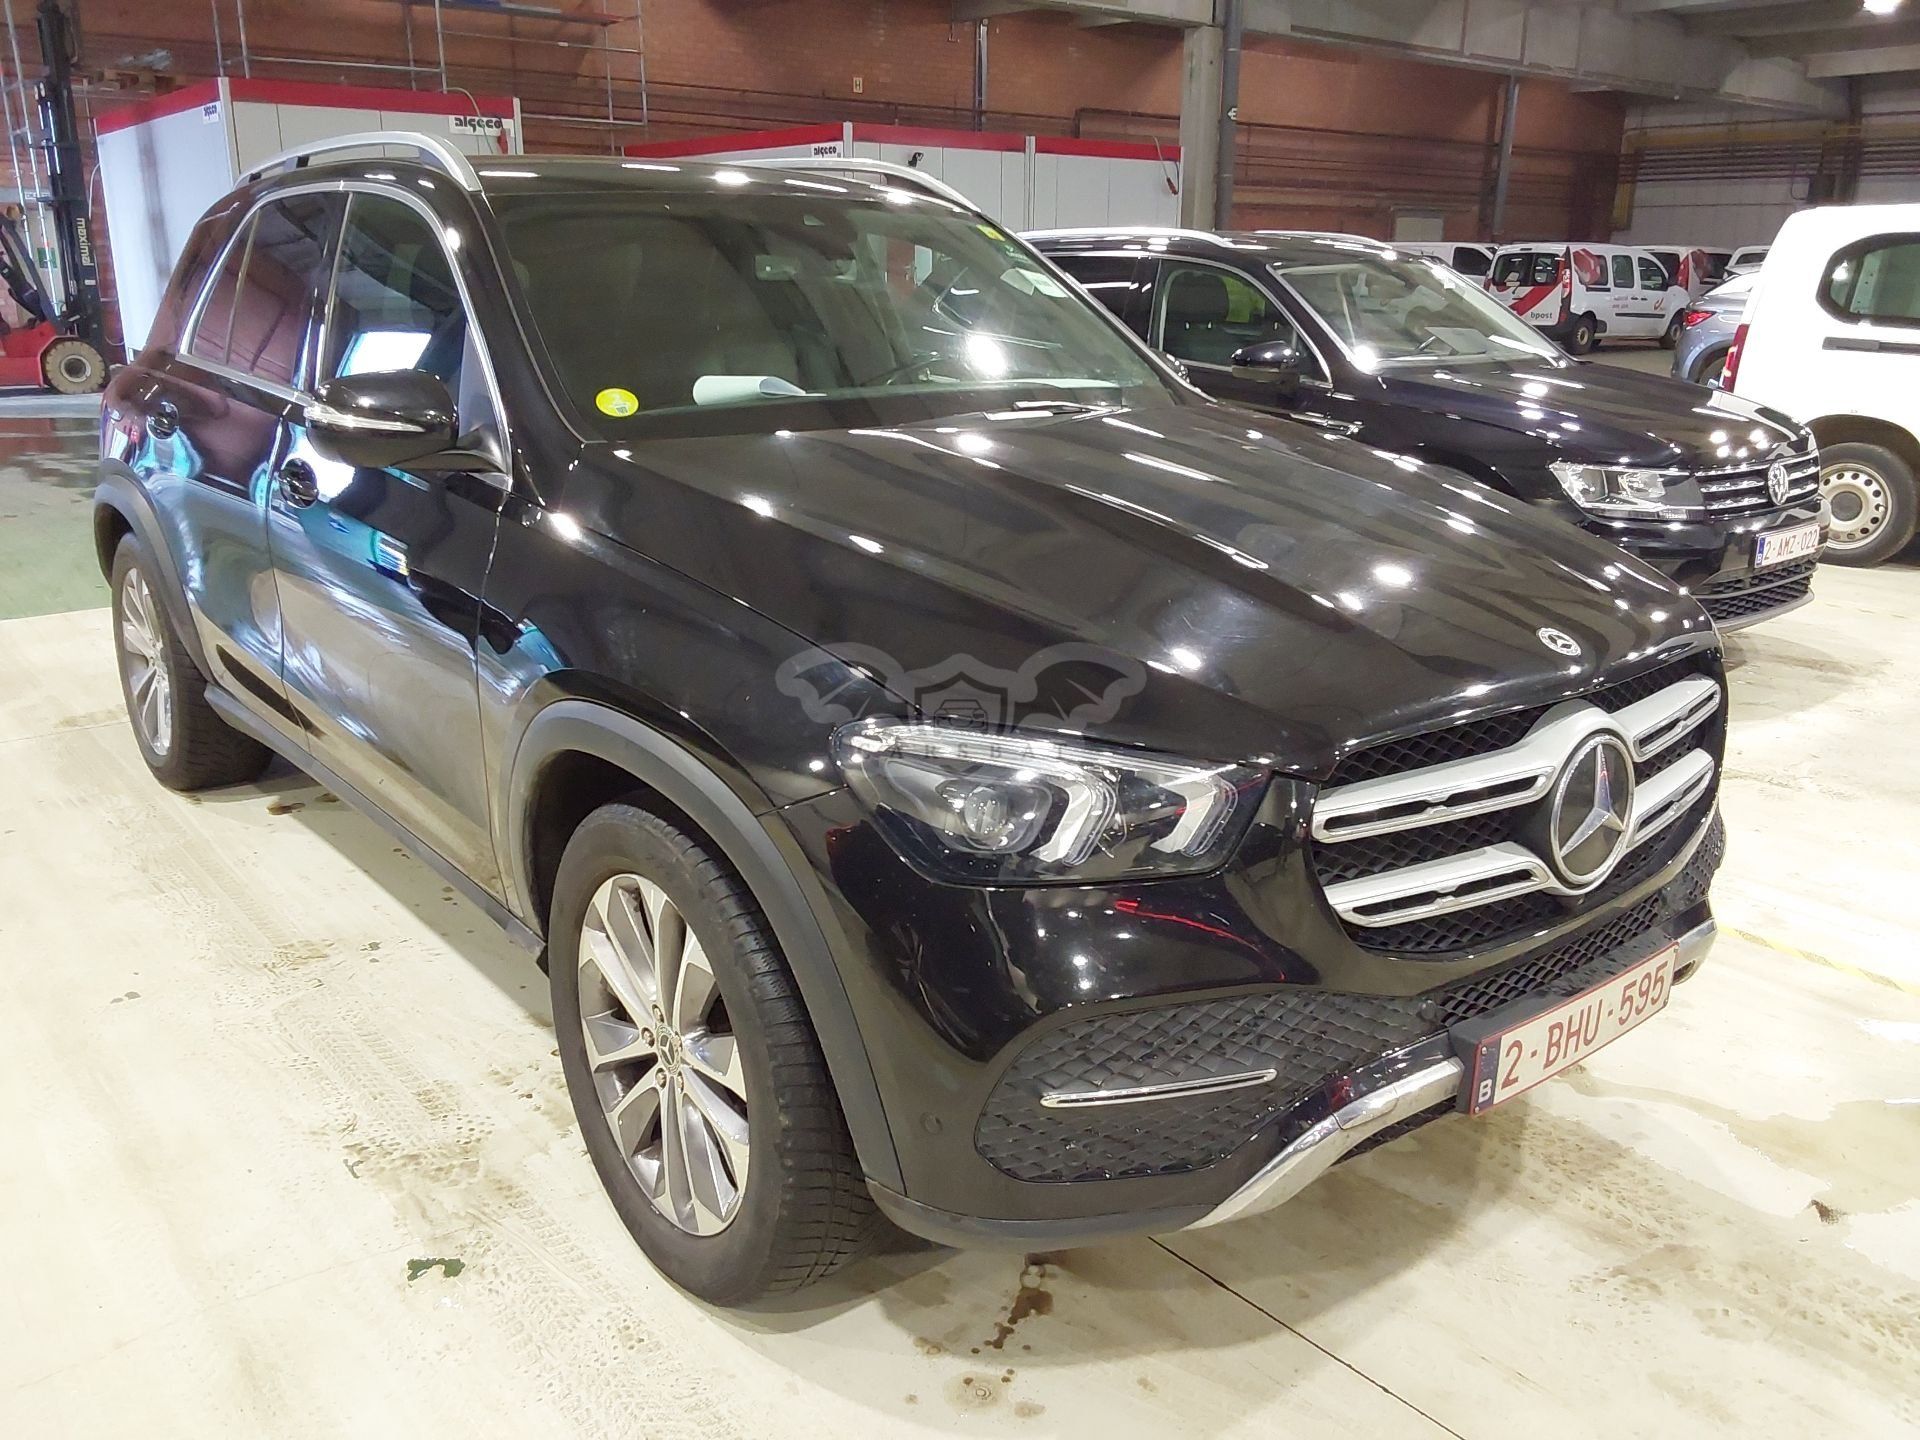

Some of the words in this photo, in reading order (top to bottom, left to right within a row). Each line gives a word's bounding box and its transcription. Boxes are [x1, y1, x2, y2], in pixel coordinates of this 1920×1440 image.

[76, 217, 95, 267] maximal
[1530, 311, 1553, 320] bpost
[1478, 1078, 1493, 1104] B
[1500, 960, 1669, 1090] 2-BHU-595
